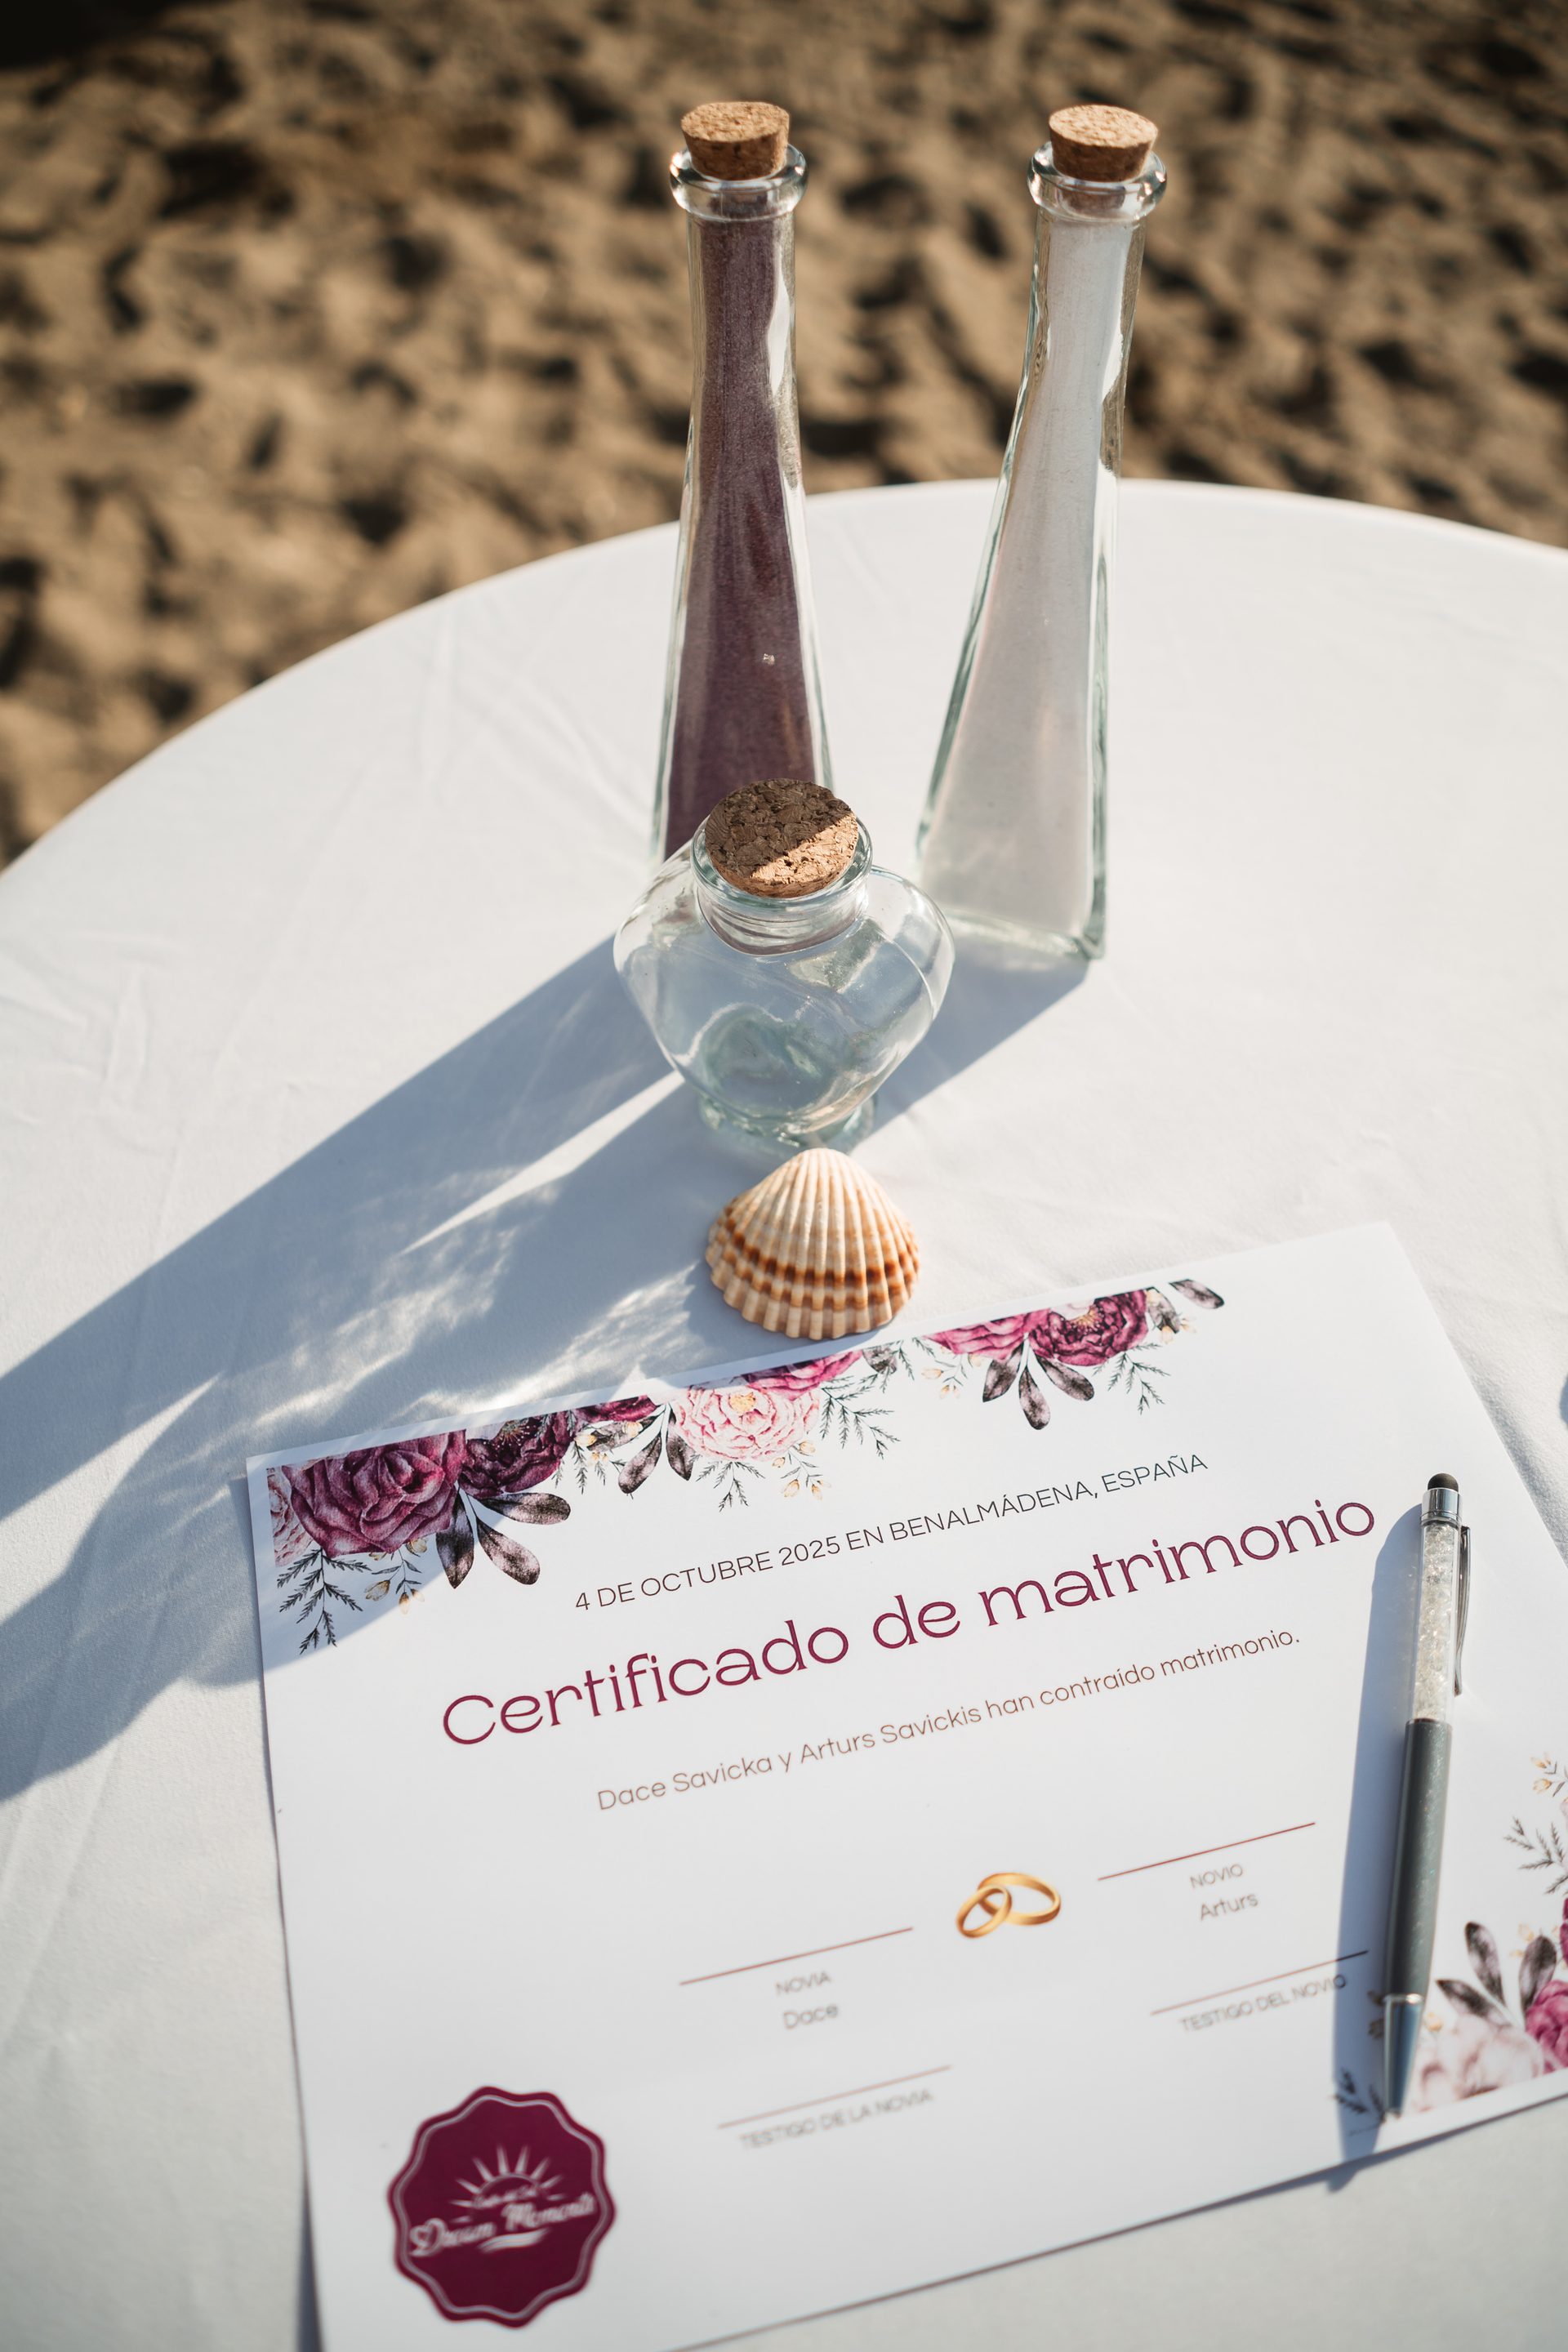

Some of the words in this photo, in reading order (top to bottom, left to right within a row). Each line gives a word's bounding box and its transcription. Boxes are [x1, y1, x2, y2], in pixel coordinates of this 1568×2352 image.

[575, 1592, 591, 1611] 4
[596, 1581, 636, 1608] DE
[640, 1550, 774, 1597] OCTUBRE
[777, 1535, 841, 1566] 2025
[844, 1526, 884, 1551] EN
[889, 1481, 1099, 1542] BENALMÁDENA,
[1100, 1454, 1209, 1493] ESPAÑA
[442, 1619, 852, 1745] Certificado
[872, 1593, 961, 1650] de
[977, 1498, 1375, 1628] matrimonio
[597, 1781, 666, 1811] Dace
[672, 1757, 773, 1793] Savicka
[777, 1751, 791, 1774] y
[800, 1733, 876, 1765] Arturs
[880, 1705, 982, 1744] Savickis
[984, 1695, 1036, 1719] han
[1039, 1664, 1156, 1706] contraído
[1160, 1629, 1300, 1677] matrimonio.
[1189, 1863, 1244, 1889] NOVIO
[1200, 1893, 1259, 1922] Arturs
[775, 1971, 832, 1995] NOVIA
[1181, 2000, 1254, 2031] TESTIGO
[1256, 1991, 1290, 2012] DEL
[1291, 1974, 1347, 1999] NOVIO
[782, 2003, 840, 2030] Dace
[739, 2118, 817, 2150] TESTIGO
[821, 2109, 846, 2131] DE
[849, 2104, 871, 2123] LA
[875, 2088, 933, 2114] NOVIA
